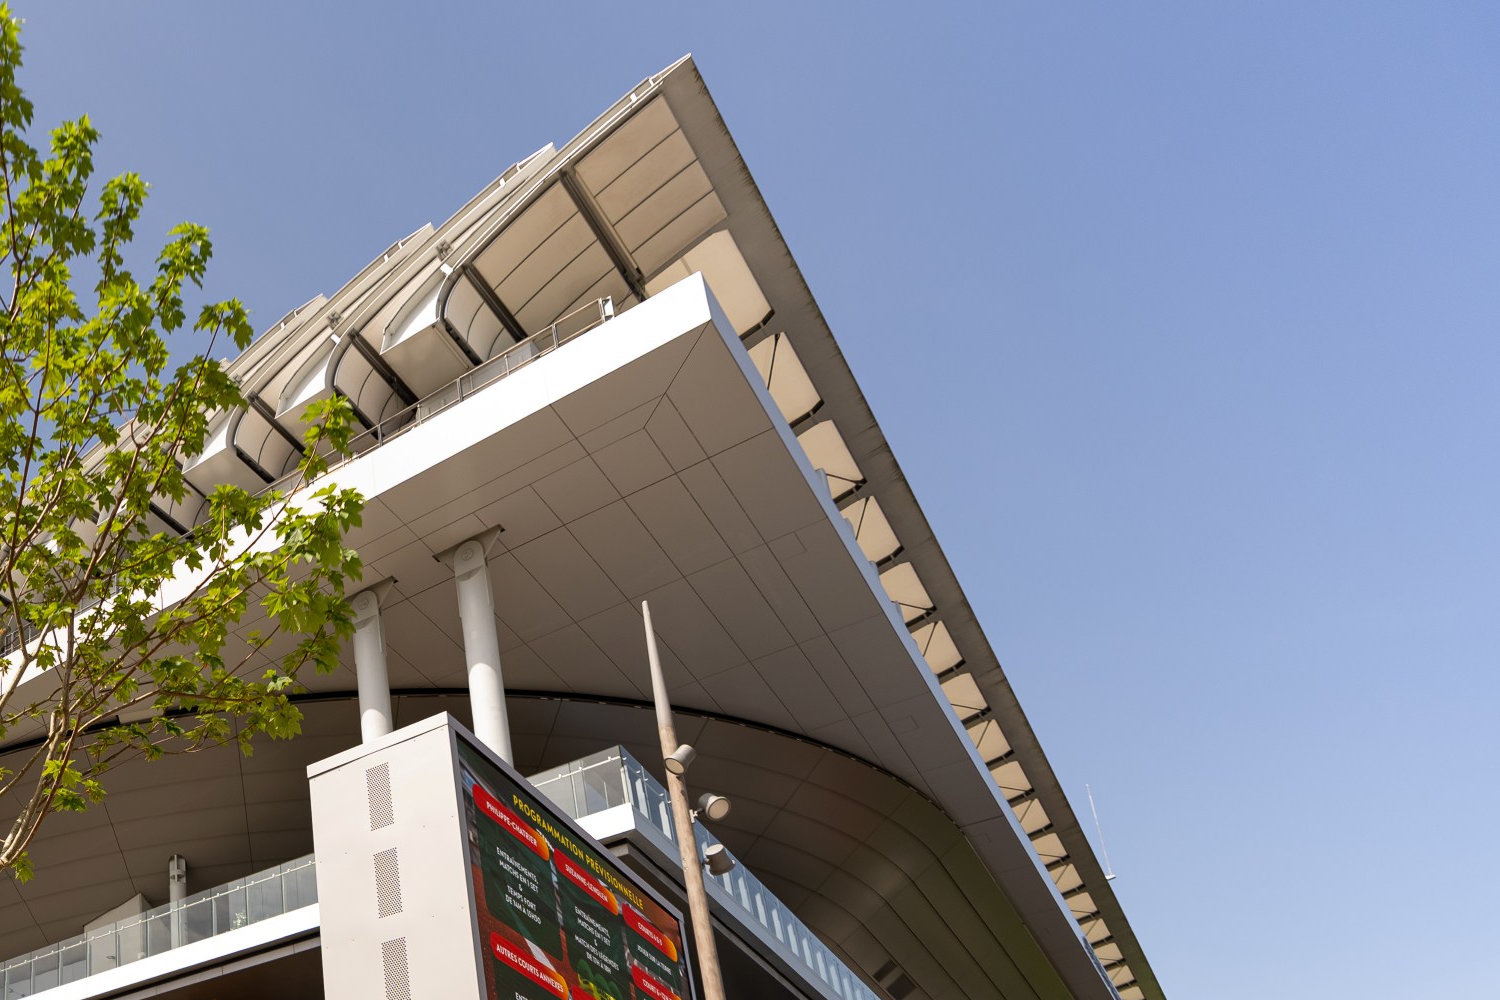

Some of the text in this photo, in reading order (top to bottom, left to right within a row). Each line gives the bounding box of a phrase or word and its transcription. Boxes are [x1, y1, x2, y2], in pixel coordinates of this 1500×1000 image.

[486, 801, 538, 848] PHILIPPE-CHATRIER
[496, 846, 539, 886] ENTRAÎNEMENTS,
[512, 793, 644, 911] PROGRAMMATION PRÉVISIONNELLE
[499, 859, 519, 880] MATCHS
[520, 874, 527, 886] EN
[530, 881, 539, 895] SET
[565, 863, 609, 904] SUZANNE-LENGLEN
[505, 894, 513, 906] DE
[513, 900, 522, 913] 14H
[507, 885, 537, 913] TEMPS FORT
[575, 906, 611, 939] ENTRAÎNEMENTS,
[577, 917, 594, 935] MATCHS
[603, 936, 611, 948] SET
[638, 921, 654, 940] COURTS
[496, 943, 564, 994] AUTRES COURTS ANNEXES
[575, 934, 620, 972] MATCH DES LÉGENDES
[586, 951, 593, 962] DE
[637, 944, 649, 959] JOUER
[660, 961, 672, 977] TERRE
[642, 978, 656, 995] COURT
